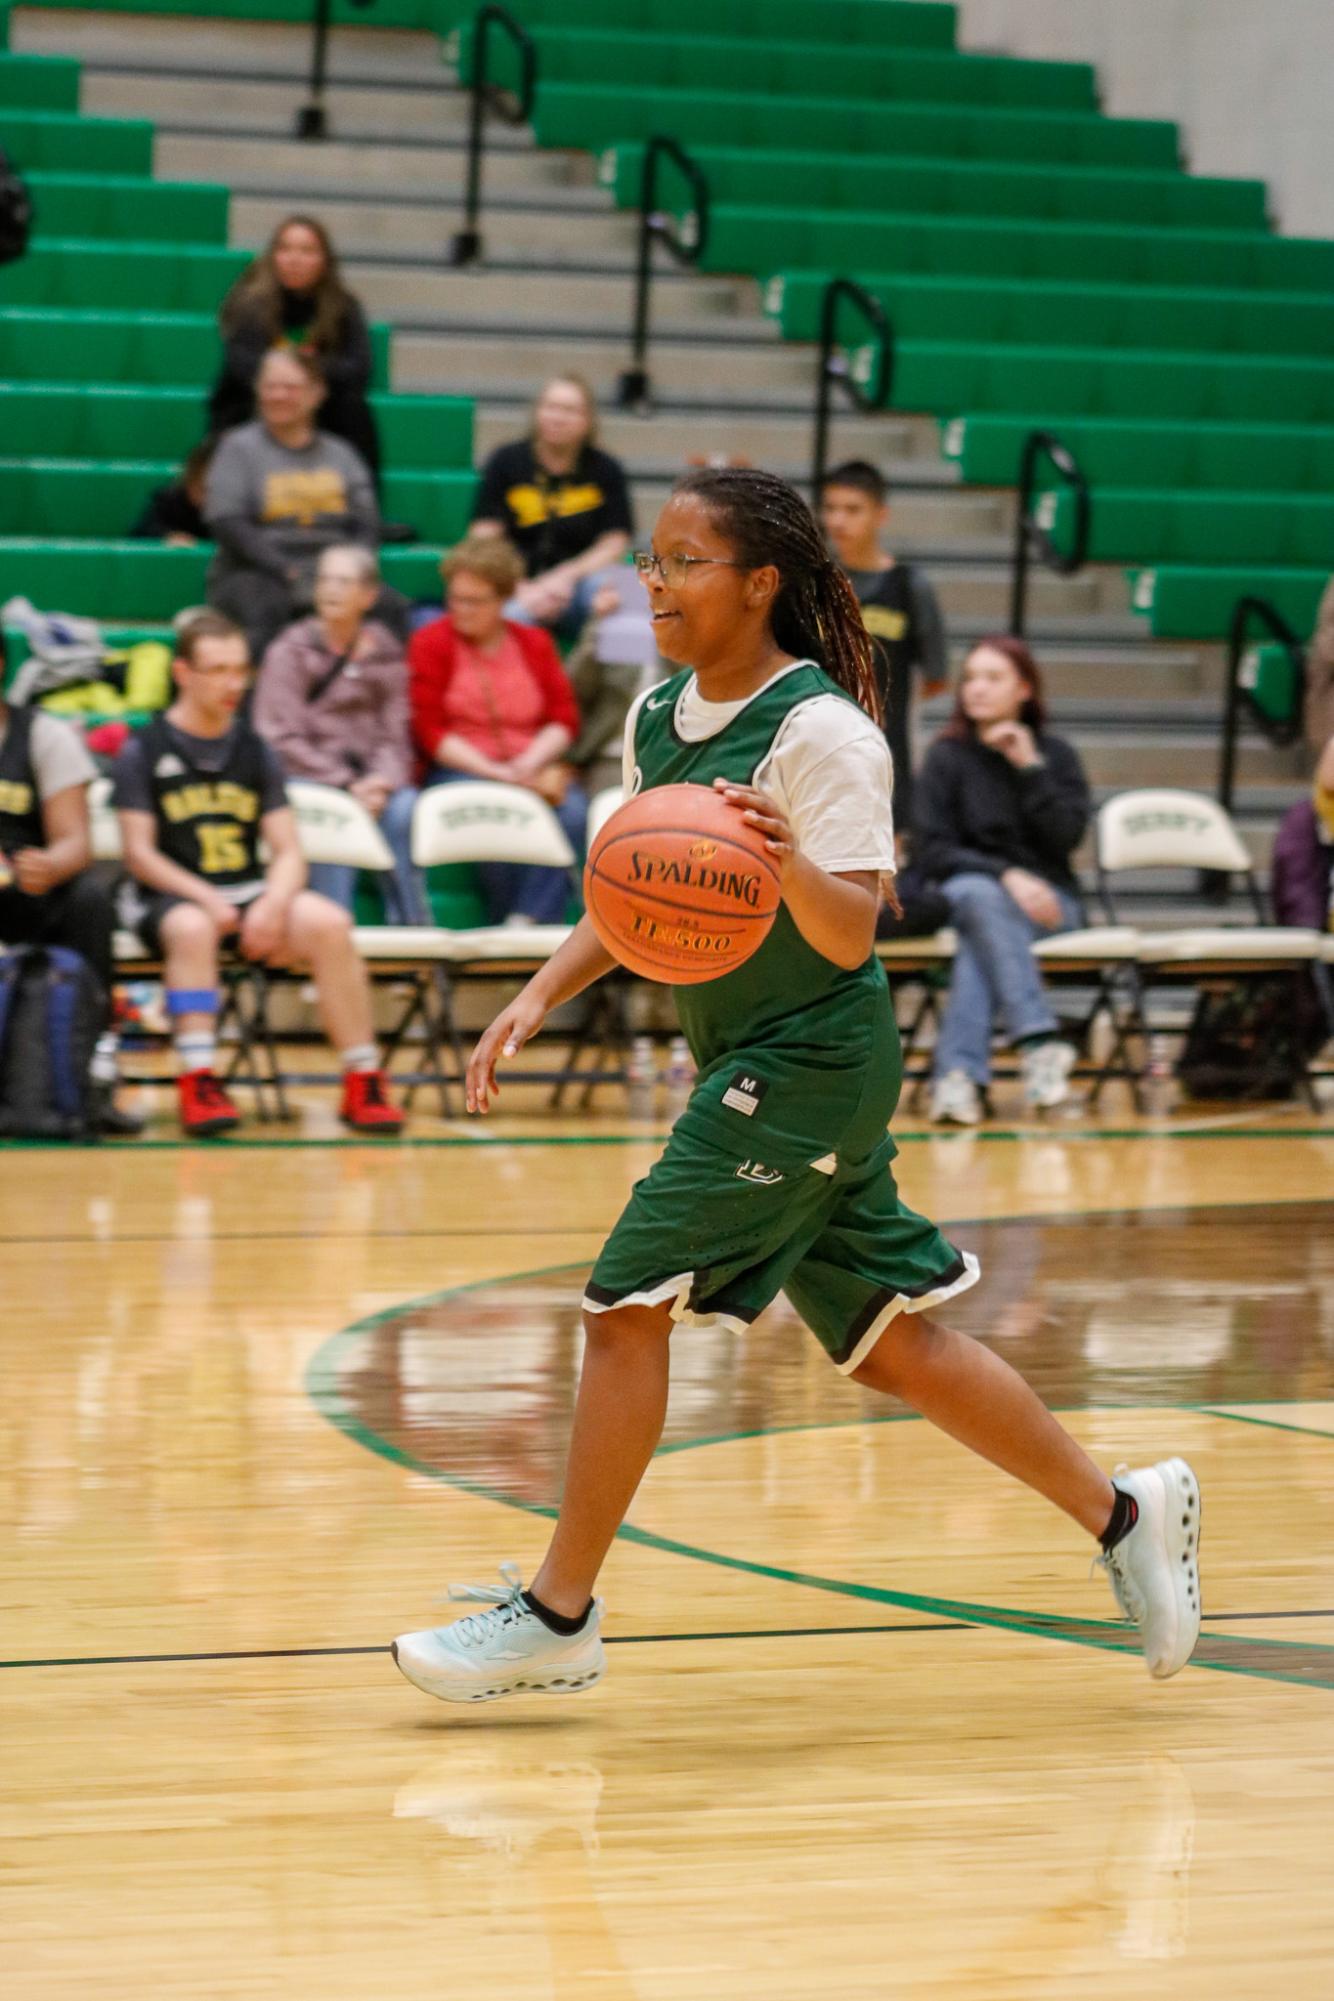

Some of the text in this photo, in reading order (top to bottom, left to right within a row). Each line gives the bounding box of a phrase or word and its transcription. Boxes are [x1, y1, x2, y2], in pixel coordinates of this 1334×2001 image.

[196, 822, 249, 874] 15
[628, 850, 761, 907] SPALDING
[740, 1077, 757, 1093] M
